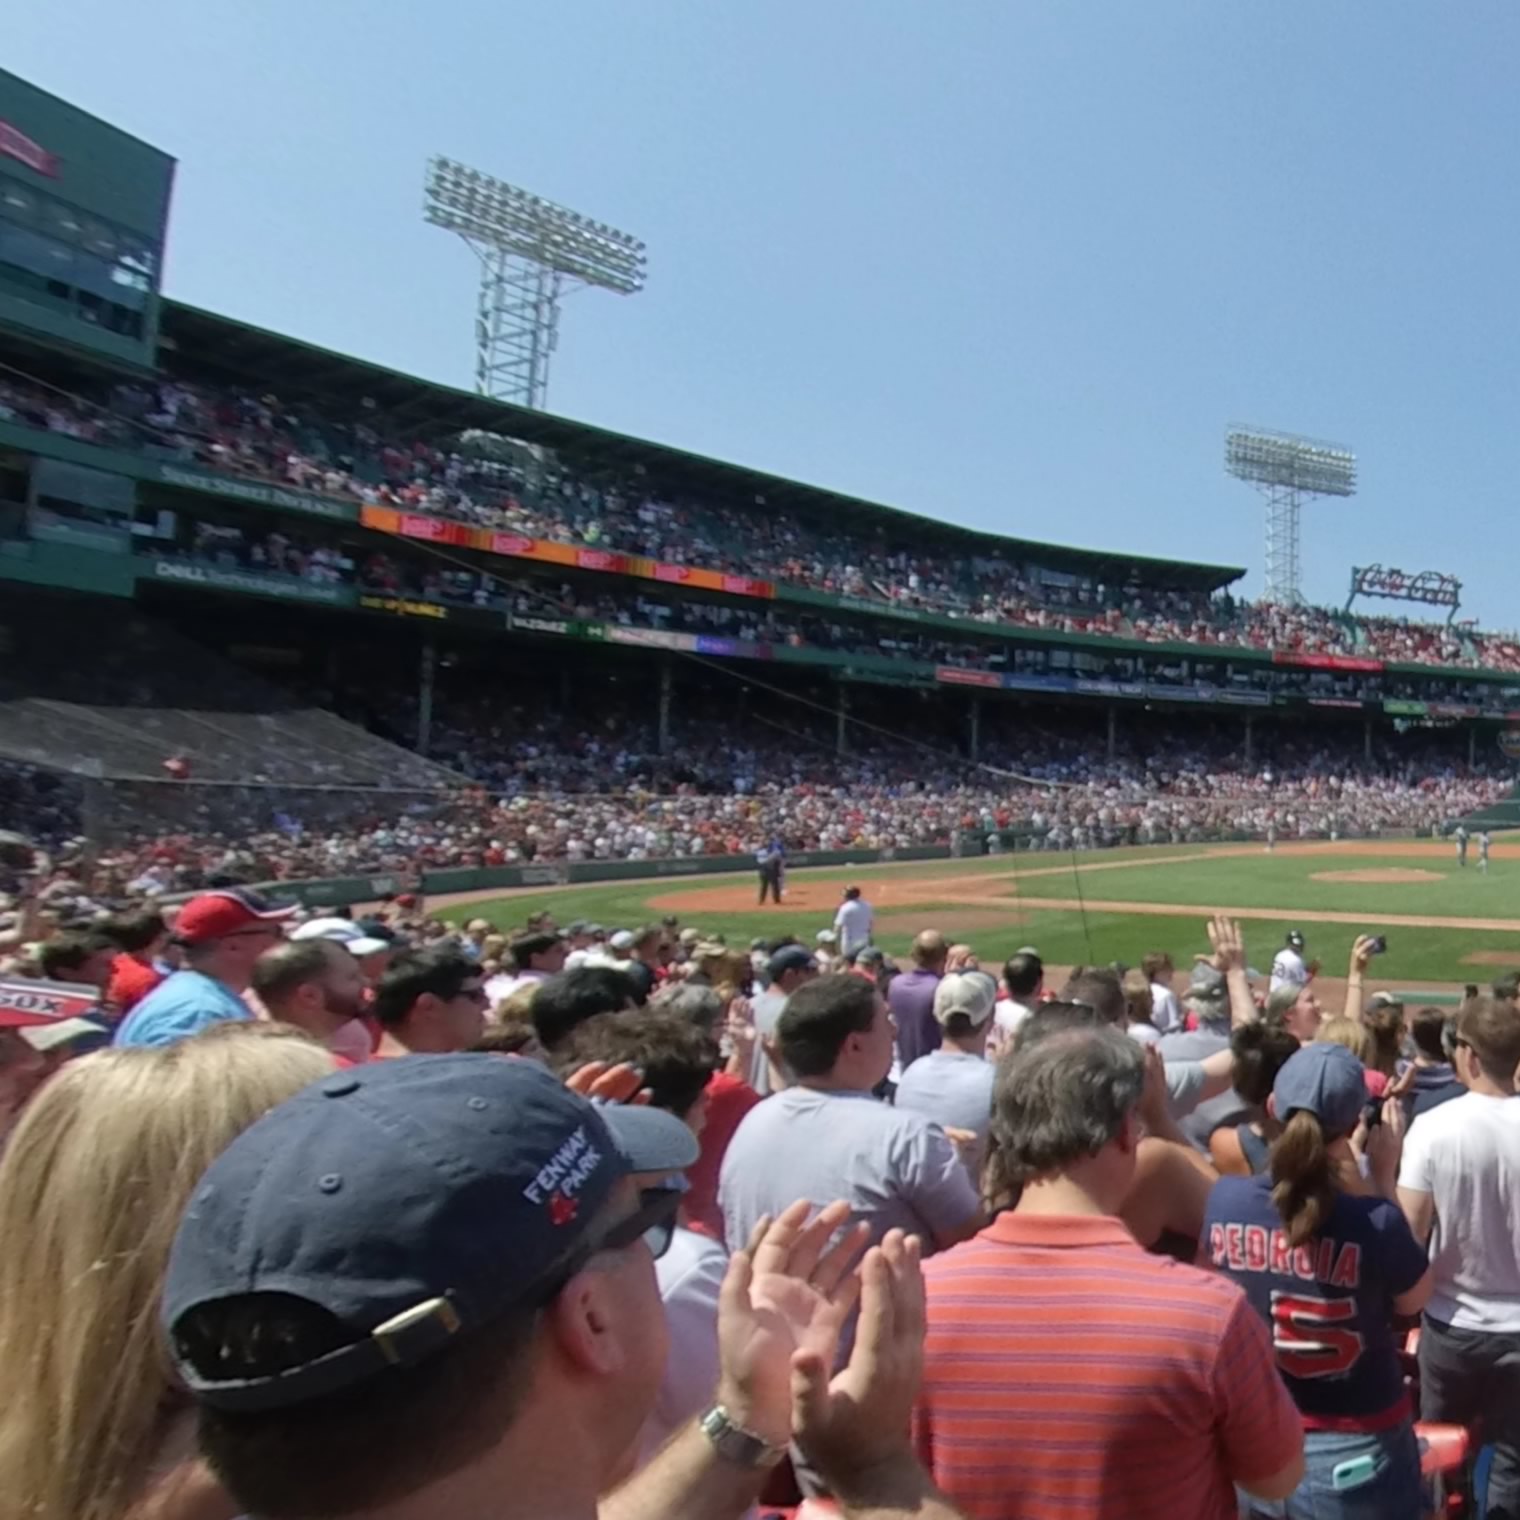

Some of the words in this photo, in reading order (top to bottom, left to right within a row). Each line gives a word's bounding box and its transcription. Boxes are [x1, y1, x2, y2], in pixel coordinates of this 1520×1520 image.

[523, 1124, 587, 1204] FENWAY
[560, 1144, 602, 1198] PARK
[1210, 1222, 1361, 1290] PEDROIA
[1269, 1290, 1364, 1379] 5
